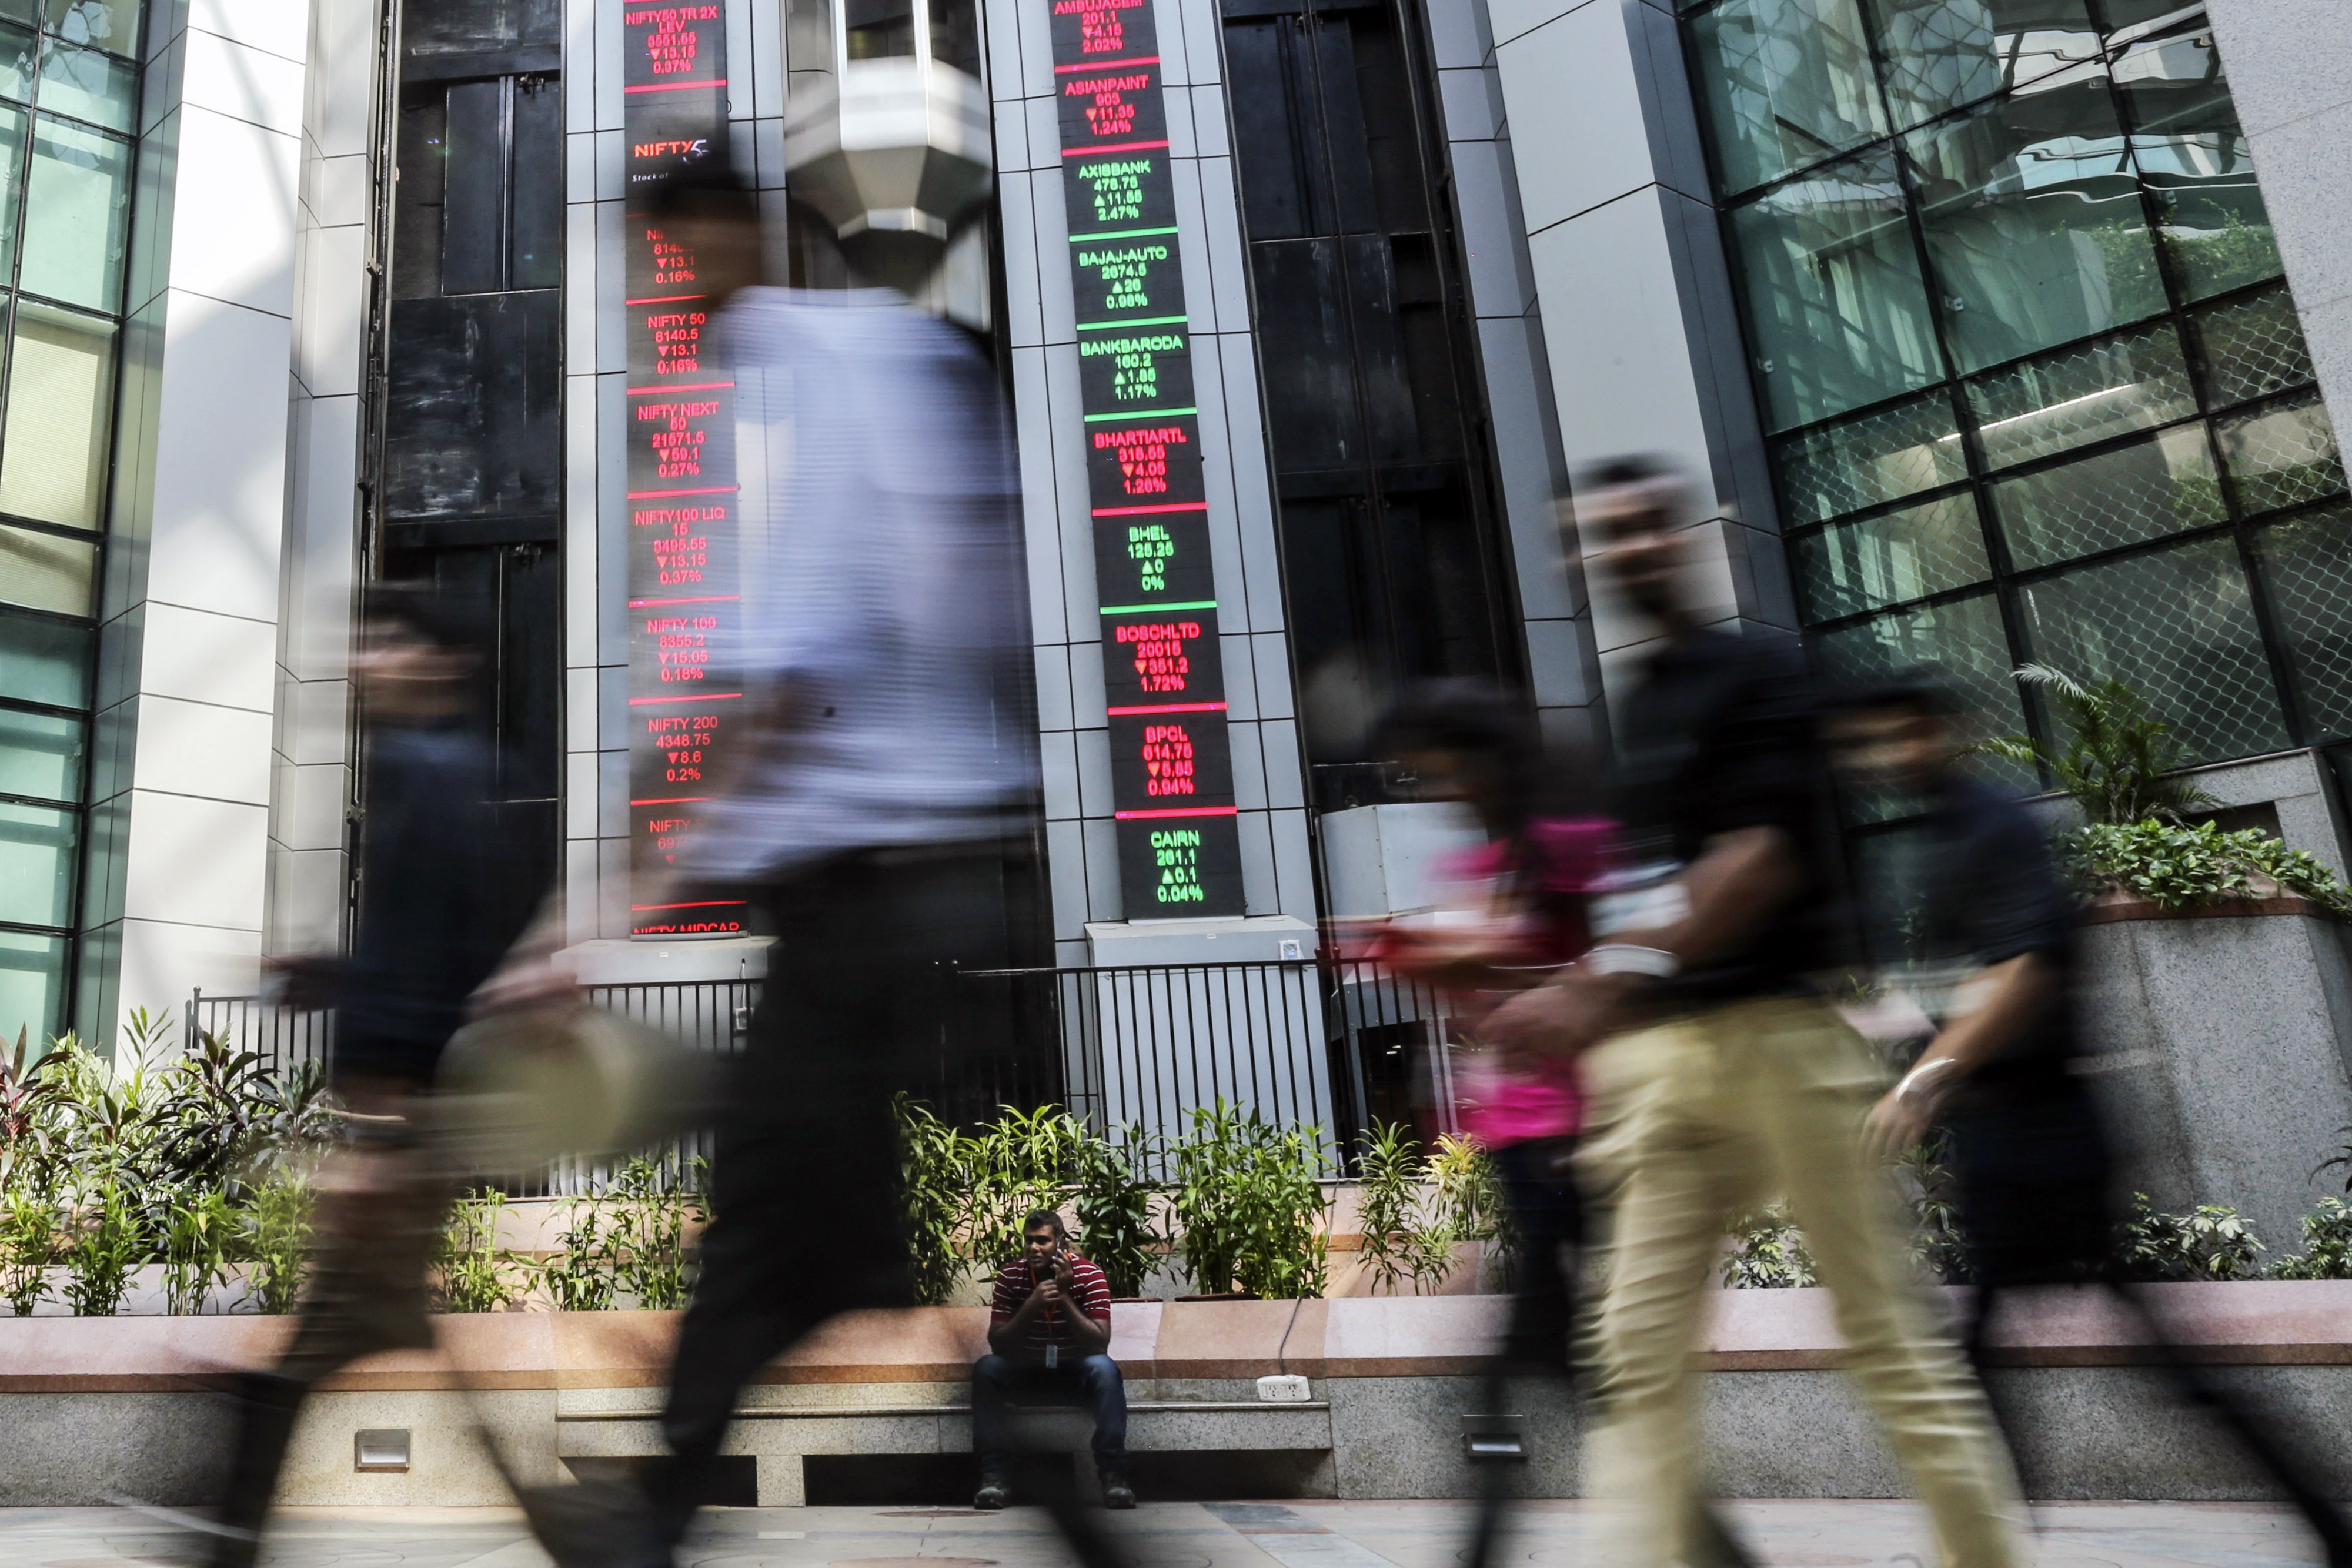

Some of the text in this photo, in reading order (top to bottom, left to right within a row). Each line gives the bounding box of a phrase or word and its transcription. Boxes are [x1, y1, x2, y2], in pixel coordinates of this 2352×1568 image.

[1065, 75, 1148, 95] ASIANPAINT
[632, 173, 657, 182] Stock
[1079, 159, 1151, 179] AXISBANK
[1078, 246, 1167, 266] BAJAJ-AUTO
[647, 313, 705, 328] NIFTY 50
[655, 328, 699, 342] 8140.5
[1081, 335, 1183, 356] BANKBARODA
[637, 402, 719, 420] NIFTY NEXT
[1094, 427, 1187, 449] BHARTIARTL
[634, 506, 726, 525] NIFTY100 LIQ
[1128, 525, 1170, 542] BHEL
[1154, 558, 1164, 574] 0
[1142, 575, 1165, 591] 0%
[647, 617, 717, 633] NIFTY 100
[1115, 622, 1201, 643] BOSCHLTD
[648, 716, 718, 732] NIFTY 200
[656, 734, 710, 748] 4348.75
[1145, 725, 1188, 743] BPCL
[681, 751, 701, 763] 8.6
[667, 768, 700, 781] 0.2%
[650, 820, 690, 833] NIFTY
[1150, 830, 1200, 848] CAIRN
[1175, 866, 1197, 884] 0.1
